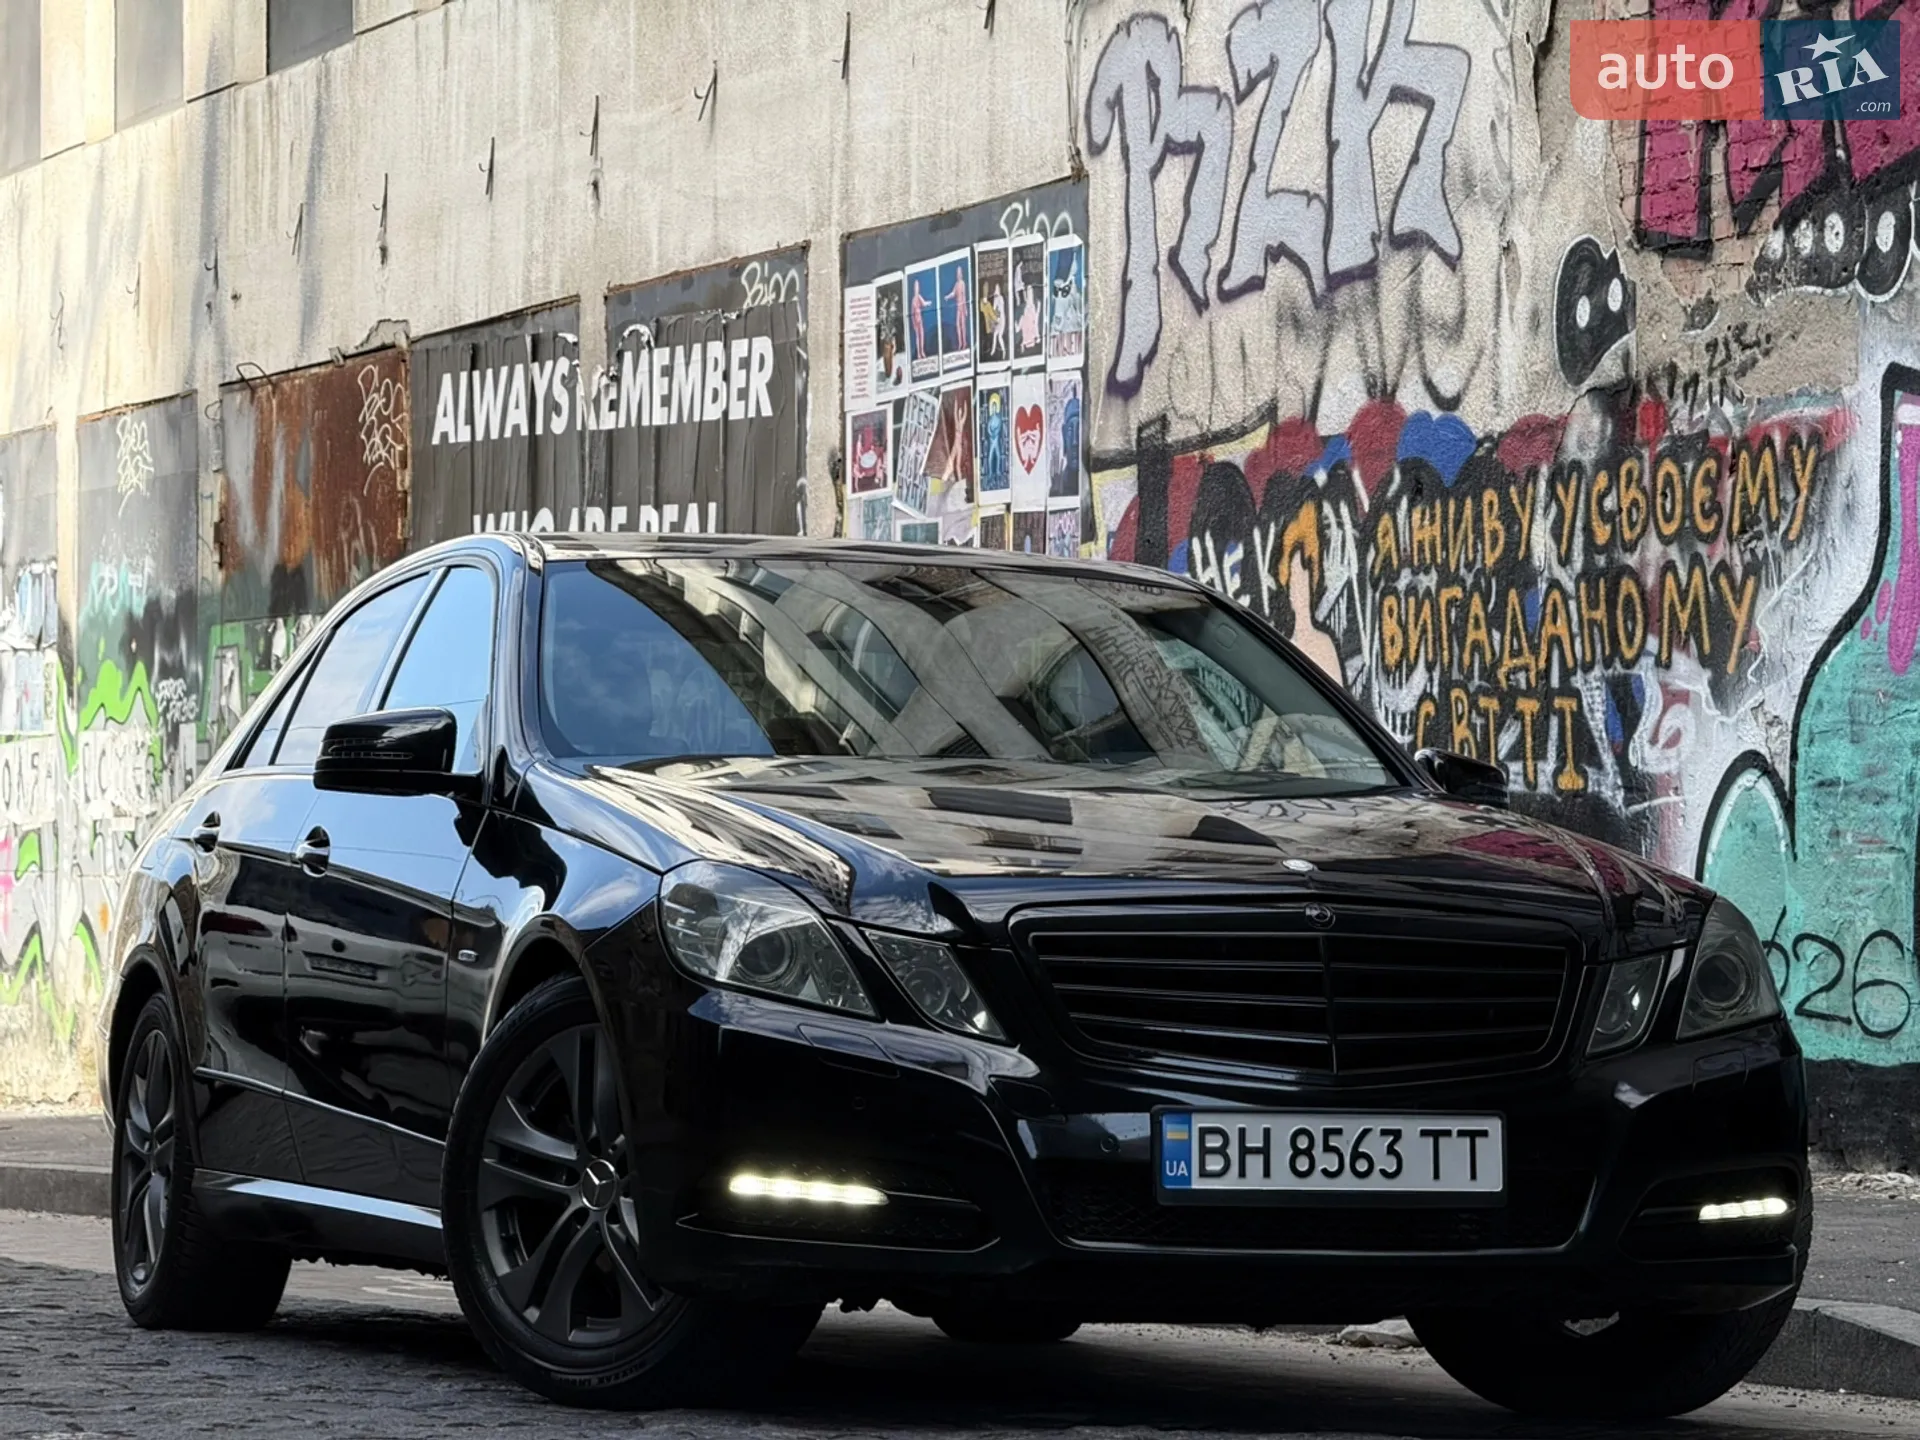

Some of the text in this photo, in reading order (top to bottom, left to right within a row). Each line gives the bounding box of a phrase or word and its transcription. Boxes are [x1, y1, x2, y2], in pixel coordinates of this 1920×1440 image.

[432, 356, 570, 446] ALWAYS
[1373, 443, 1818, 578] Я ЖИВУ У СВОЄМУ
[1379, 563, 1757, 690] ВИГАДАНОМУ
[1165, 1160, 1189, 1178] UA
[1197, 1125, 1490, 1181] BH 8563 TT
